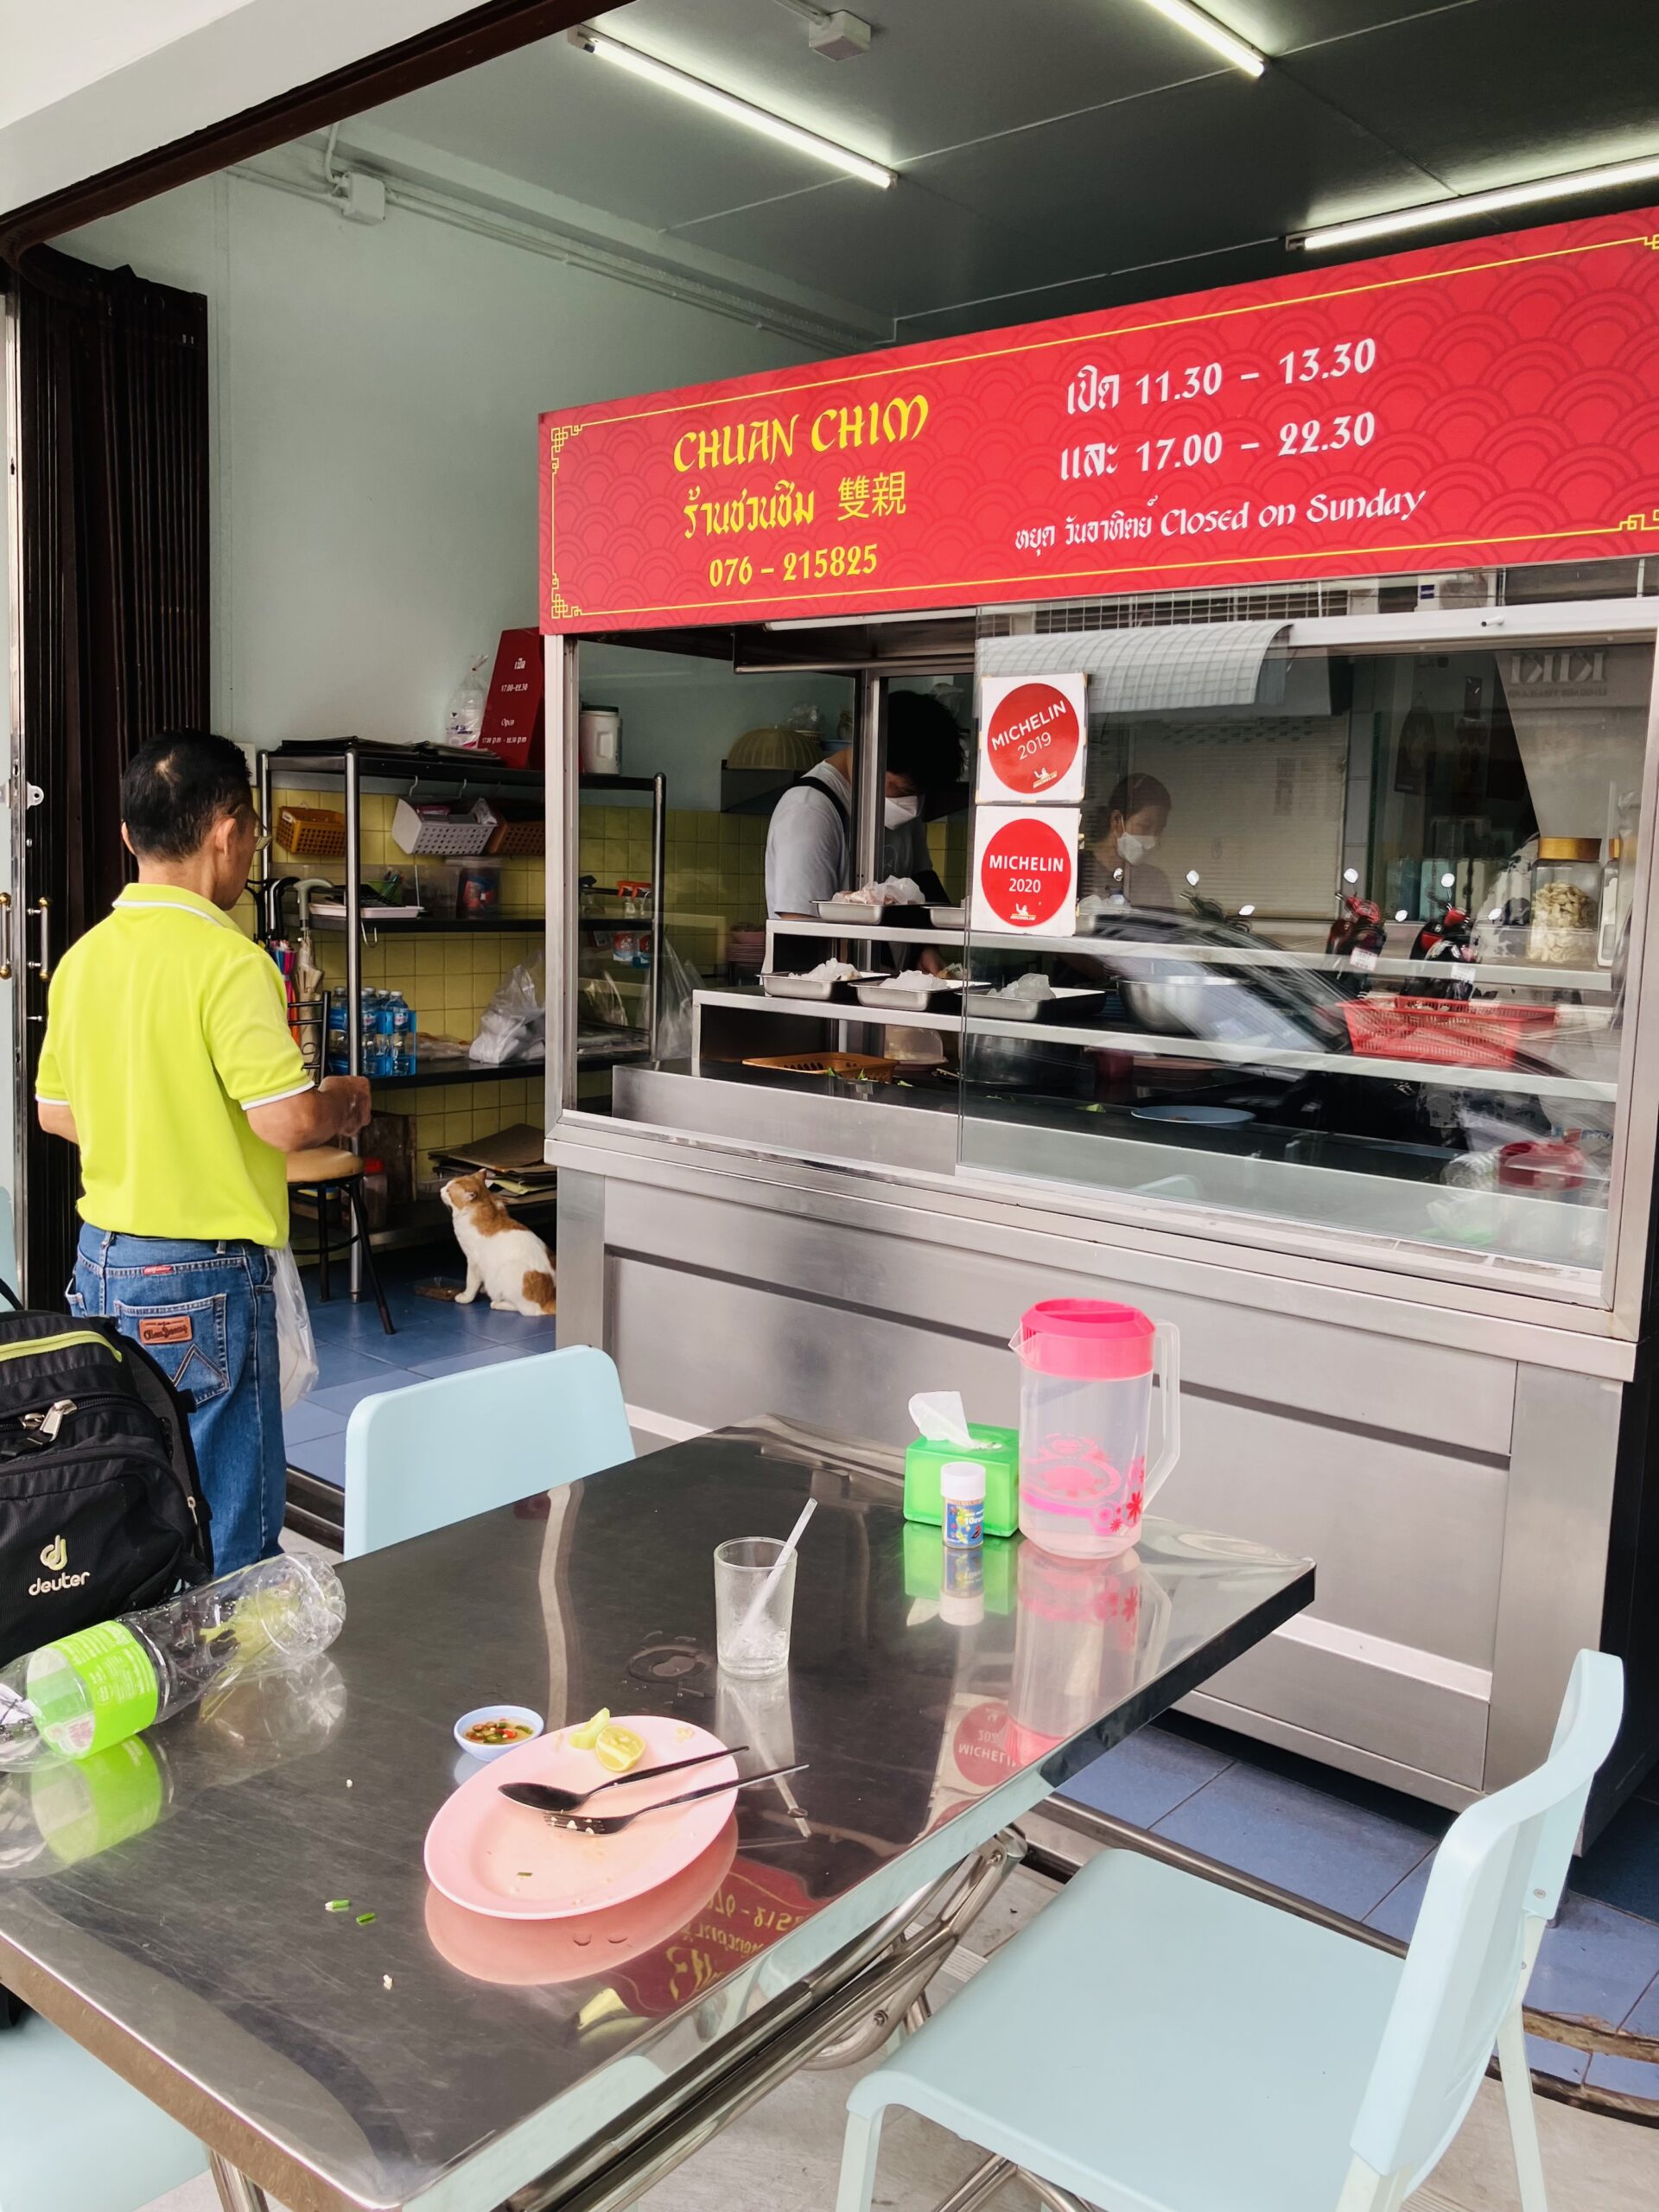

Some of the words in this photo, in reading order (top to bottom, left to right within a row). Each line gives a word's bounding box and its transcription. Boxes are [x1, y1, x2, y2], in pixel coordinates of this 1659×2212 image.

[1066, 363, 1120, 415] เปิด
[1135, 362, 1224, 406] 11.30
[1279, 337, 1376, 385] 13.30
[673, 413, 800, 474] CHUAN
[810, 393, 930, 454] CHIM
[1059, 442, 1120, 481] และ
[1135, 430, 1224, 473] 17.00
[1277, 410, 1376, 458] 22.30
[836, 470, 907, 523] 雙親
[1014, 523, 1056, 557] หยุด
[1065, 494, 1160, 546] วันอาทิตย์
[1160, 501, 1249, 537] Closed
[1258, 502, 1297, 526] on
[1306, 487, 1427, 524] Sunday
[709, 556, 753, 588] 076
[782, 543, 879, 583] 215825
[991, 700, 1067, 752] MICHELIN
[1017, 732, 1052, 760] 2019
[989, 855, 1065, 873] MICHELIN
[1008, 877, 1042, 893] 2020
[29, 1571, 91, 1595] deuter
